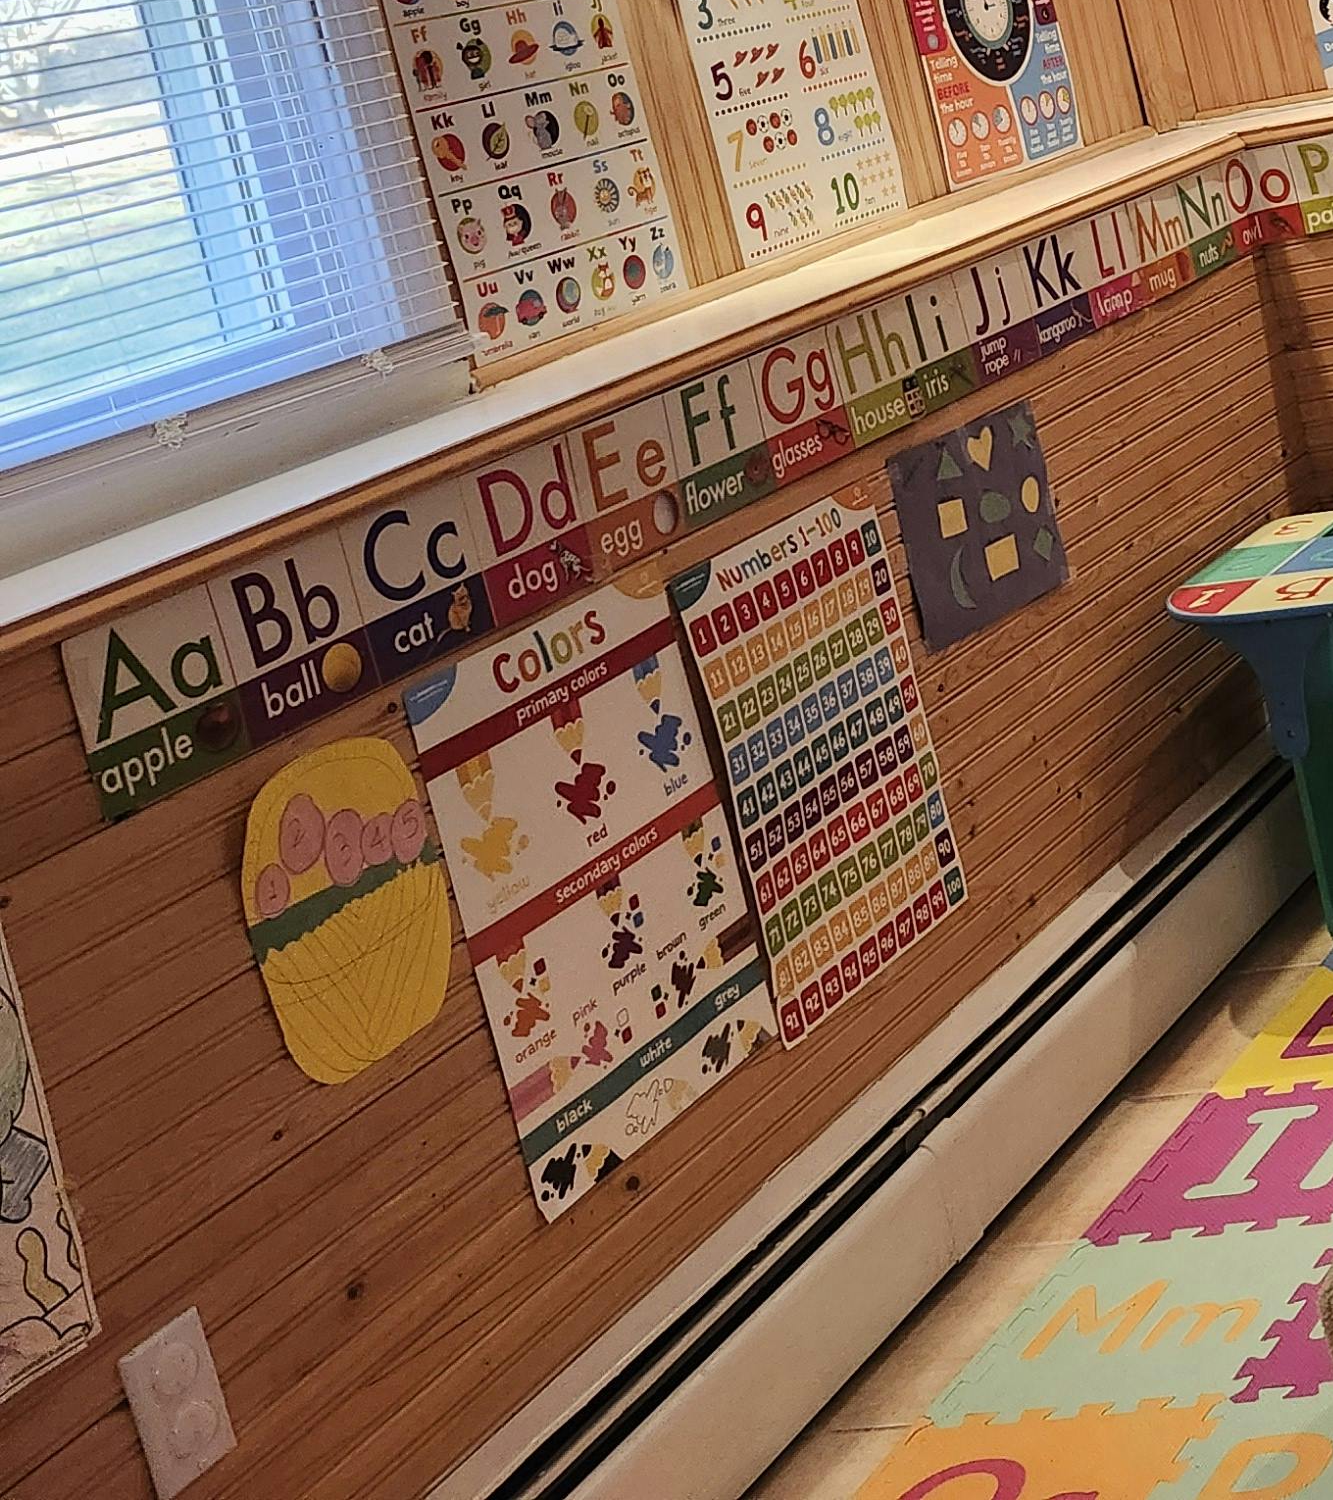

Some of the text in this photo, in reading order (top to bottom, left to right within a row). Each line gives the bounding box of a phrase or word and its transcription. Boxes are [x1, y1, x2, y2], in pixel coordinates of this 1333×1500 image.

[936, 80, 971, 101] BEFORE
[1242, 216, 1263, 246] owl
[1022, 234, 1083, 309] Kk
[1197, 242, 1221, 268] nuts
[1148, 266, 1177, 293] mug
[1096, 286, 1135, 317] lamp
[1035, 313, 1078, 346] kangaroo
[978, 334, 1008, 362] jump
[984, 354, 1011, 376] rope
[924, 367, 950, 401] iris
[850, 395, 907, 436] house
[771, 432, 825, 480] glasses
[683, 471, 747, 517] flower
[600, 517, 644, 556] egg
[714, 507, 842, 592] Numbers 1-100
[506, 557, 559, 600] dog
[230, 557, 340, 669] Bb
[393, 611, 436, 654] cat
[491, 609, 606, 694] Colors
[260, 659, 322, 719] ball
[515, 660, 609, 728] primary colors
[100, 726, 195, 797] apple
[662, 772, 690, 798] blue
[585, 822, 609, 848] red
[554, 825, 659, 905] secondary colors
[698, 902, 728, 932] green
[655, 931, 688, 961] brown
[611, 962, 649, 997] purple
[713, 983, 742, 1011] grey
[571, 996, 599, 1027] pink
[514, 1027, 559, 1065] orange
[638, 1035, 674, 1068] white
[554, 1098, 595, 1134] black
